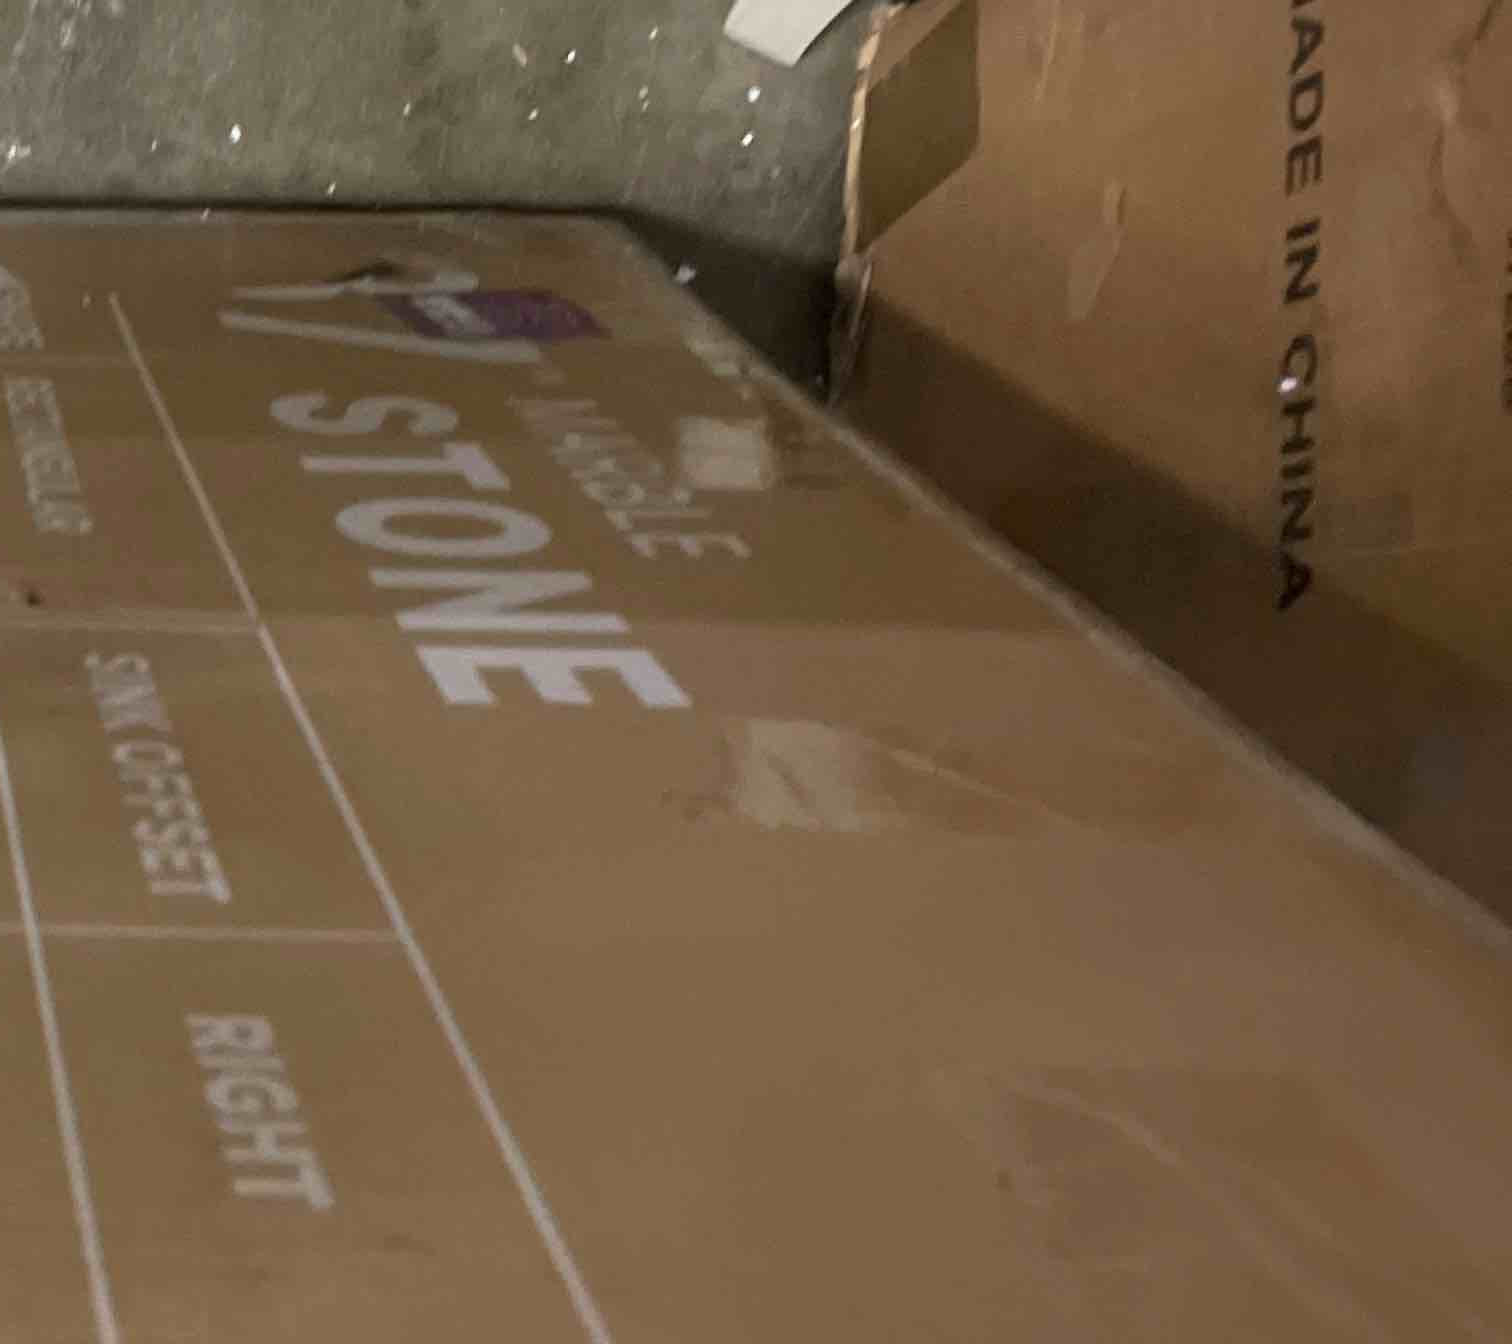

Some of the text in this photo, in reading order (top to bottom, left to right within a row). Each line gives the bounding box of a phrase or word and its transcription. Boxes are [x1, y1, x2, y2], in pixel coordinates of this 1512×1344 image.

[1280, 214, 1323, 306] IN
[269, 390, 691, 709] STONE
[1276, 334, 1322, 613] CHINA
[85, 652, 233, 905] SINK OFFSET
[187, 1012, 335, 1211] RIGHT
